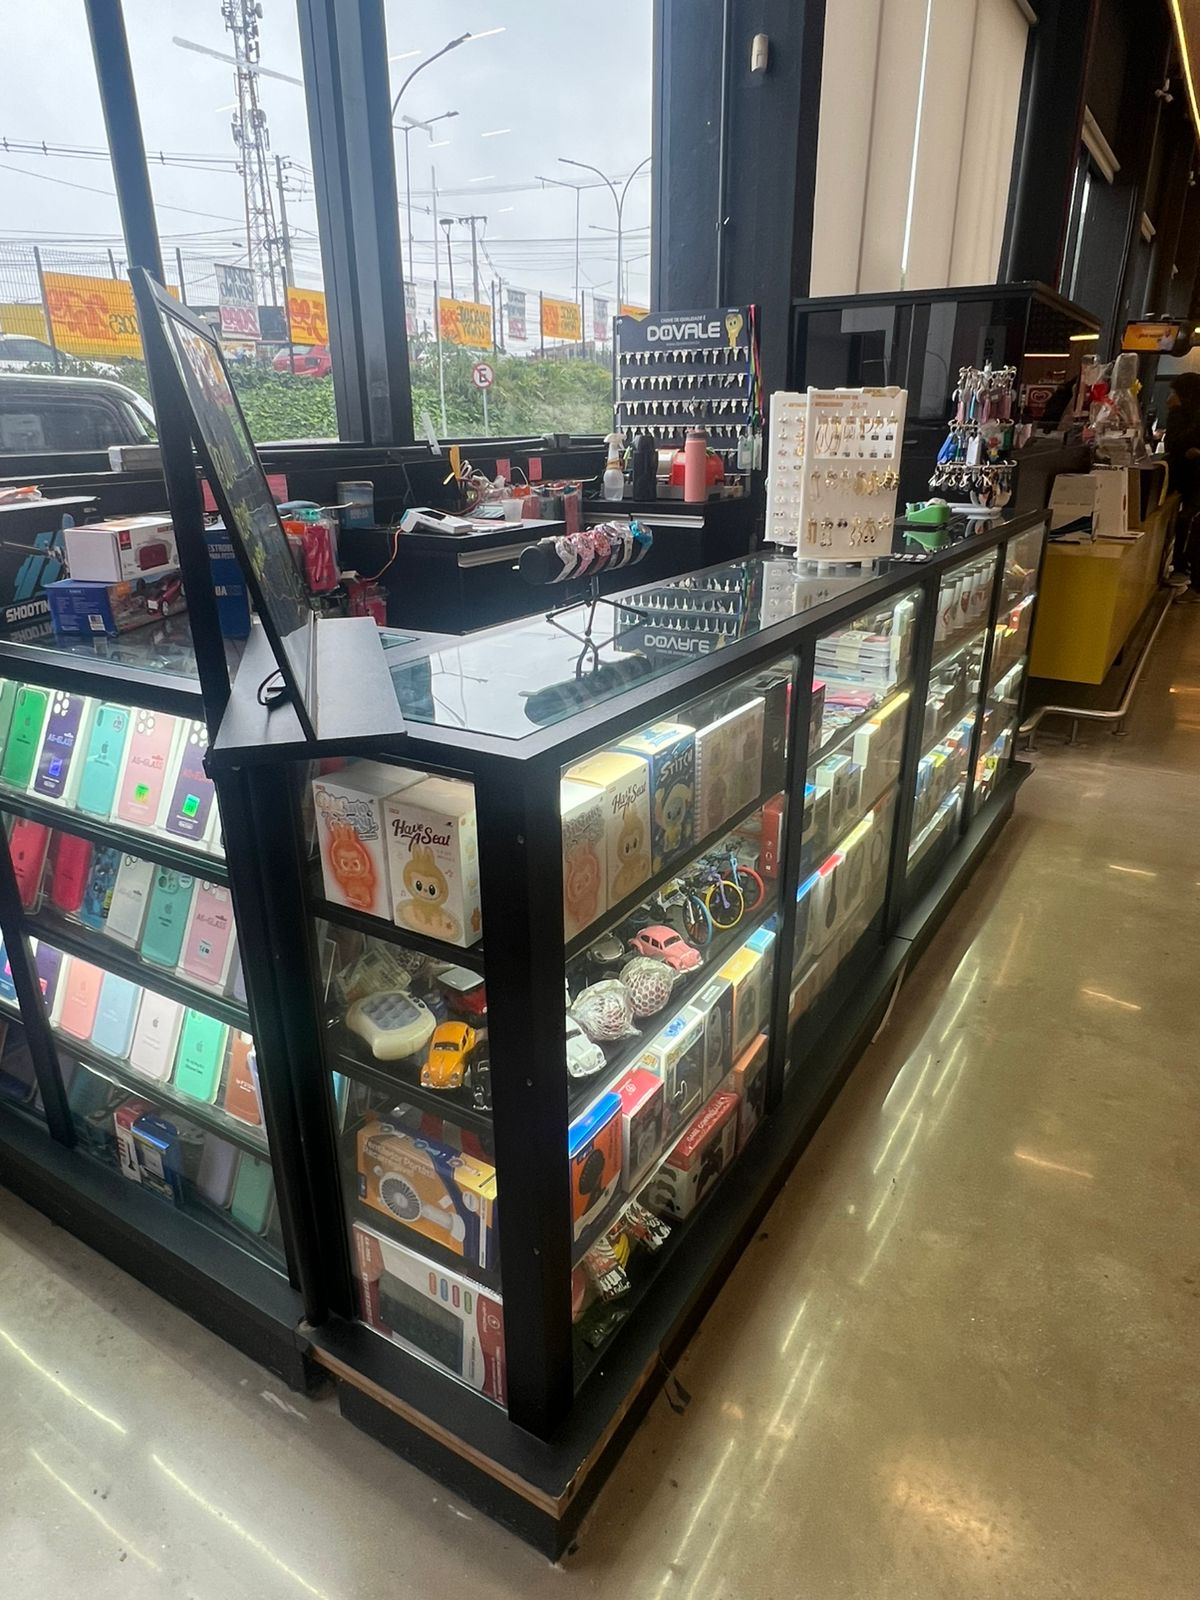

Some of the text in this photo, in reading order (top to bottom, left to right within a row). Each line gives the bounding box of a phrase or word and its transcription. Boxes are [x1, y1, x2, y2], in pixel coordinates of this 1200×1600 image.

[647, 321, 720, 342] DOVALE
[478, 367, 488, 382] E
[392, 818, 424, 837] Have
